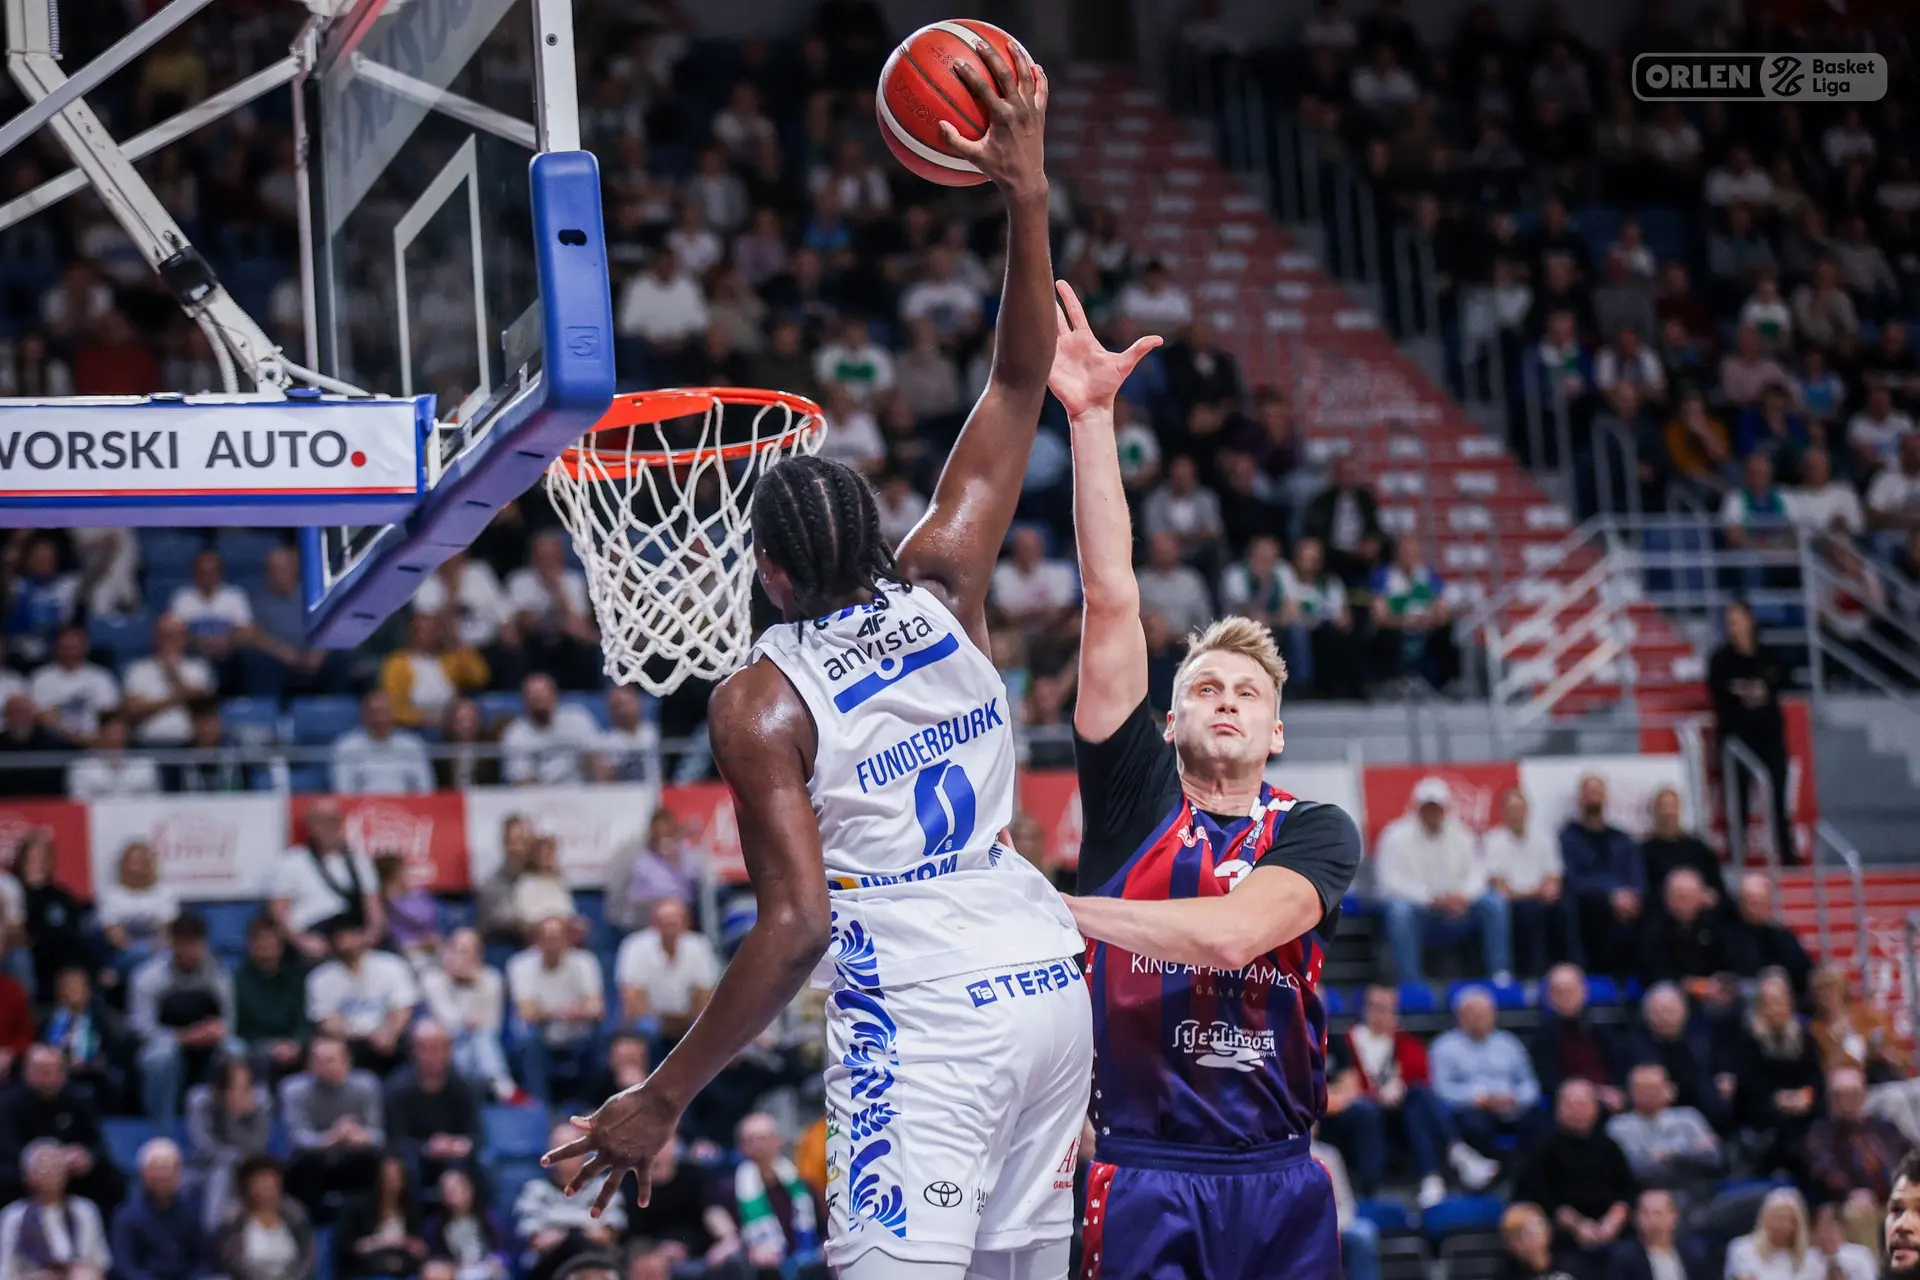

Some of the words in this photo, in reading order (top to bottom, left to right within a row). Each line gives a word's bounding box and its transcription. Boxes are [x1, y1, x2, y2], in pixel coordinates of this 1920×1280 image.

[823, 616, 933, 681] anvista
[856, 613, 886, 638] 4F
[856, 697, 1004, 794] FUNDERBURK
[914, 758, 976, 857] 0
[1131, 953, 1177, 974] KING
